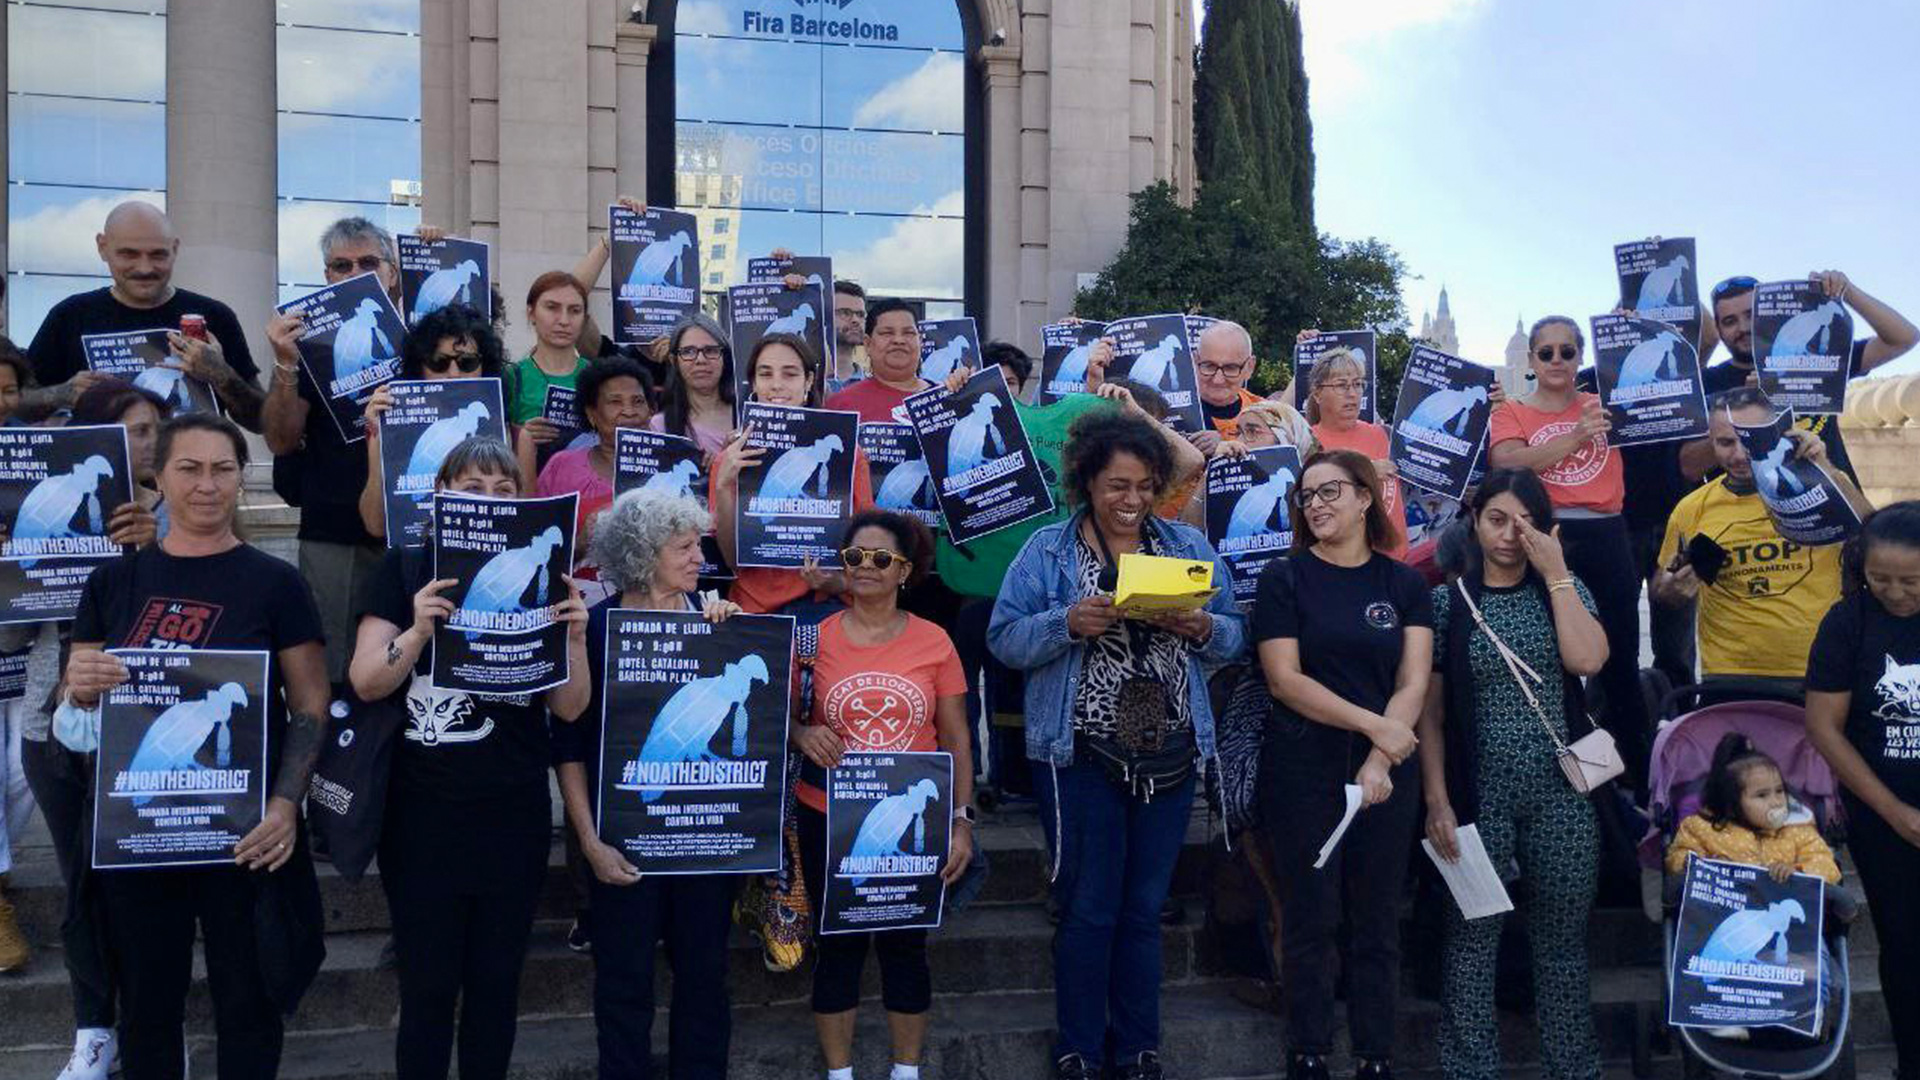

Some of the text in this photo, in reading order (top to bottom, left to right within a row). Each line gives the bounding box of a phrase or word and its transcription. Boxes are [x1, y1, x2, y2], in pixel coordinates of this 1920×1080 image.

[744, 11, 898, 41] Fira Barcelona
[442, 502, 517, 516] JORNADA DE LLUITA
[748, 496, 842, 514] #NOATHEDISTRICT
[169, 603, 182, 614] AL
[620, 621, 712, 635] JORNADA DE LLUITA
[150, 656, 160, 667] DE
[165, 656, 190, 667] LLUITA
[618, 658, 700, 670] HOTEL CATALONIA
[618, 670, 698, 684] BARCELONA PLAZA
[857, 676, 872, 686] DE
[138, 685, 180, 696] CATALONIA
[1886, 726, 1900, 738] EM
[1901, 748, 1911, 759] LA
[622, 760, 768, 784] #NOATHEDISTRICT
[114, 770, 250, 791] #NOATHEDISTRICT
[682, 803, 740, 814] INTERNACIONAL
[183, 816, 192, 826] LA
[193, 816, 210, 826] VIDA
[665, 814, 724, 826] CONTRA LA VIDA
[840, 856, 940, 873] #NOATHEDISTRICT
[1688, 955, 1806, 982] #NOATHEDISTRICT
